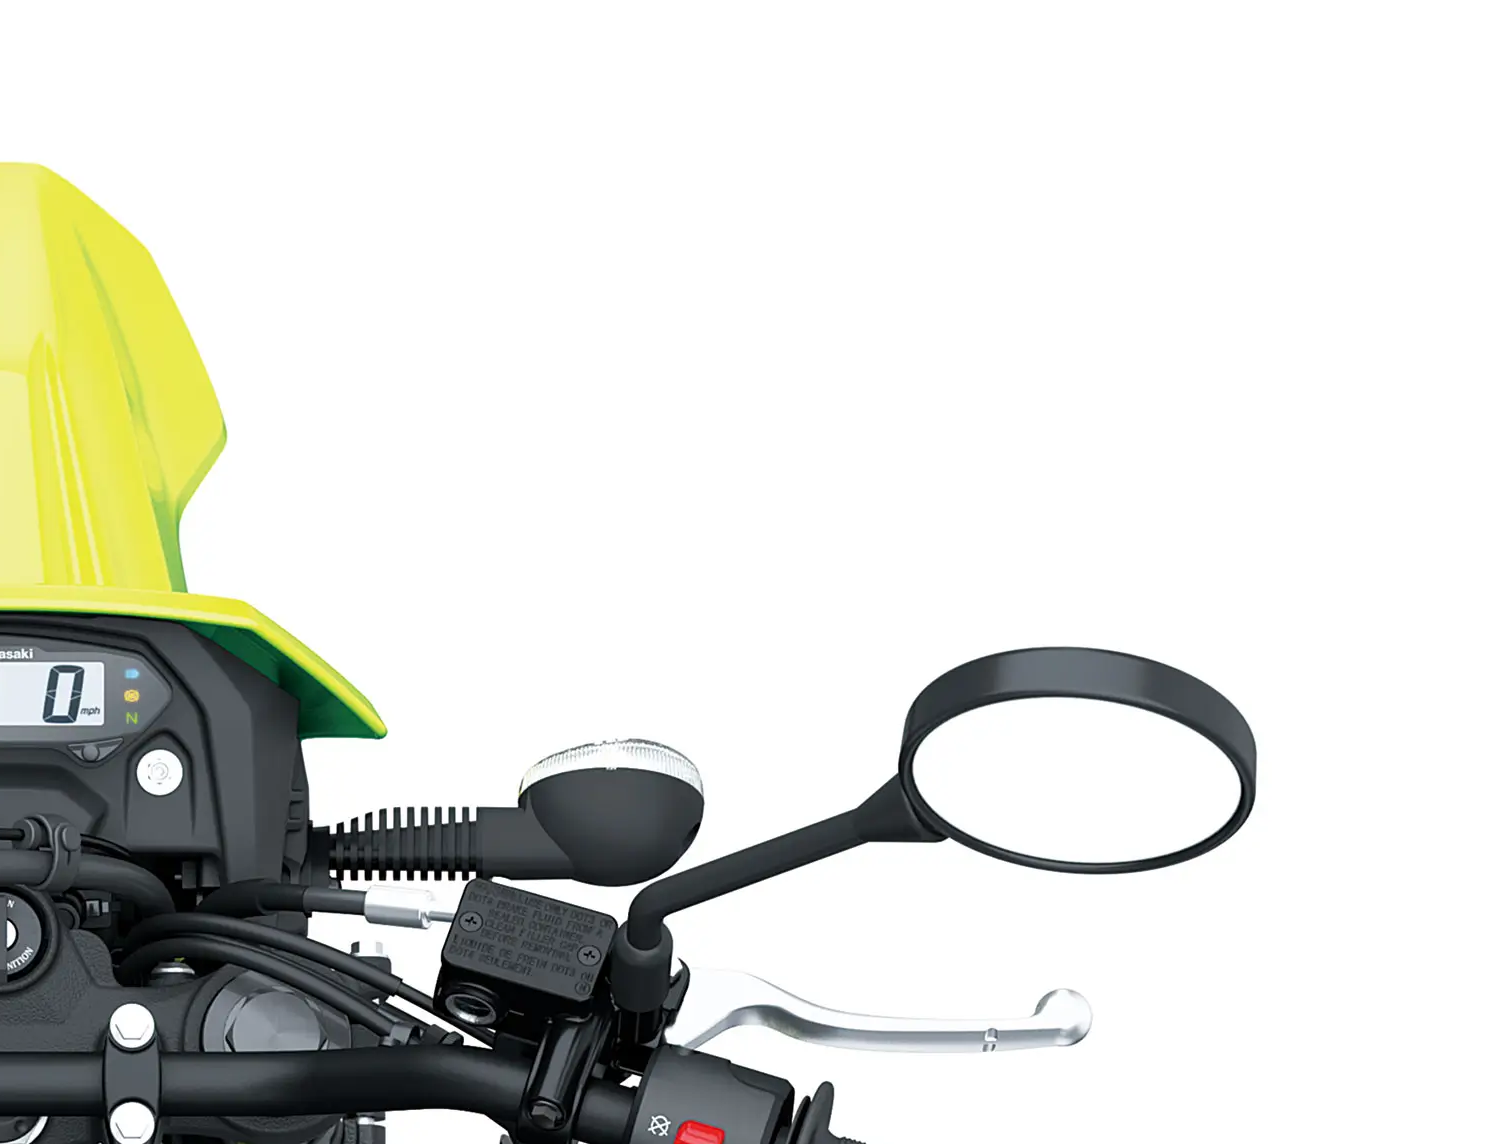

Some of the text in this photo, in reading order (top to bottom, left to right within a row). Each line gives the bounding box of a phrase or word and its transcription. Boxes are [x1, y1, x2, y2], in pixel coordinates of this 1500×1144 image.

[43, 664, 85, 724] 0
[80, 706, 101, 716] mph
[126, 711, 138, 725] N
